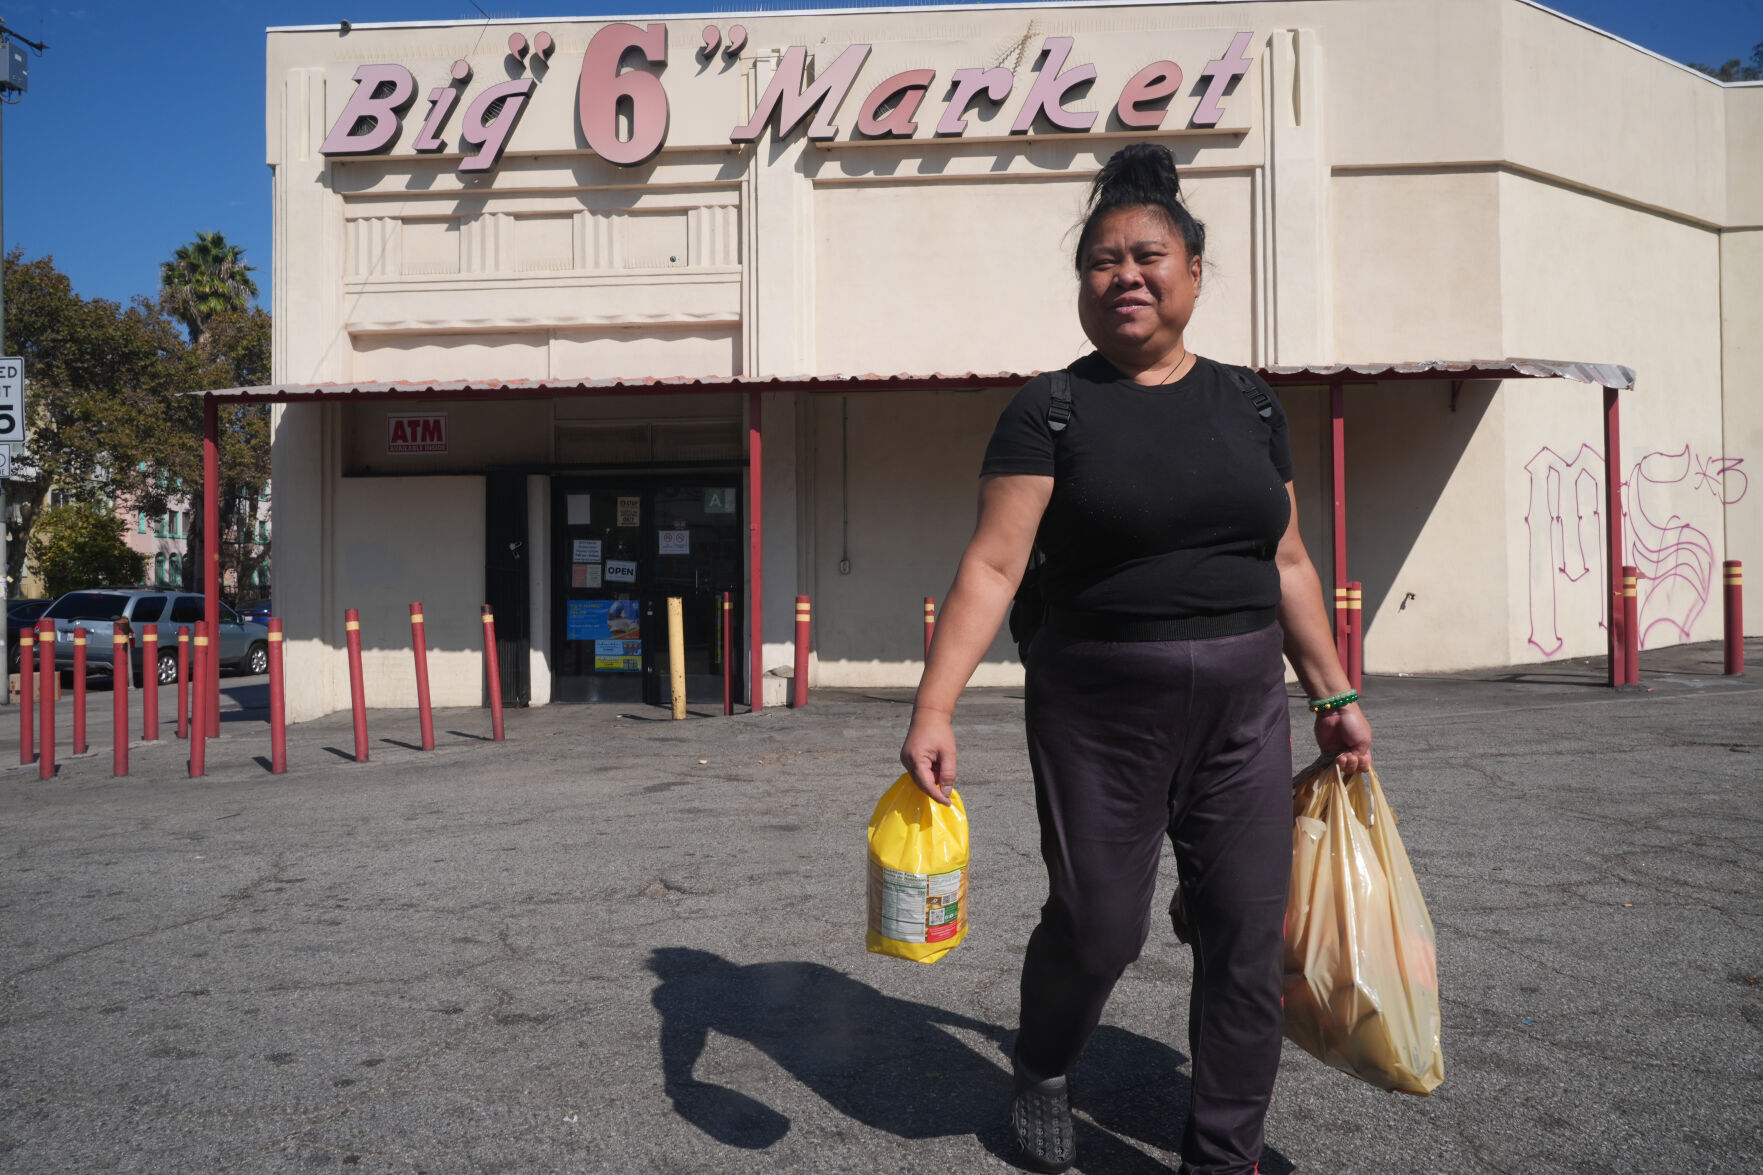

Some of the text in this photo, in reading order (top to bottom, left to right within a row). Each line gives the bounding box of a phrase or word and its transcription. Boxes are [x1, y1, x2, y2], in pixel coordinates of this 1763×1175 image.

[318, 60, 538, 173] Big
[729, 31, 1255, 144] Market
[391, 419, 444, 443] ATM
[709, 493, 723, 507] A
[608, 566, 634, 576] OPEN
